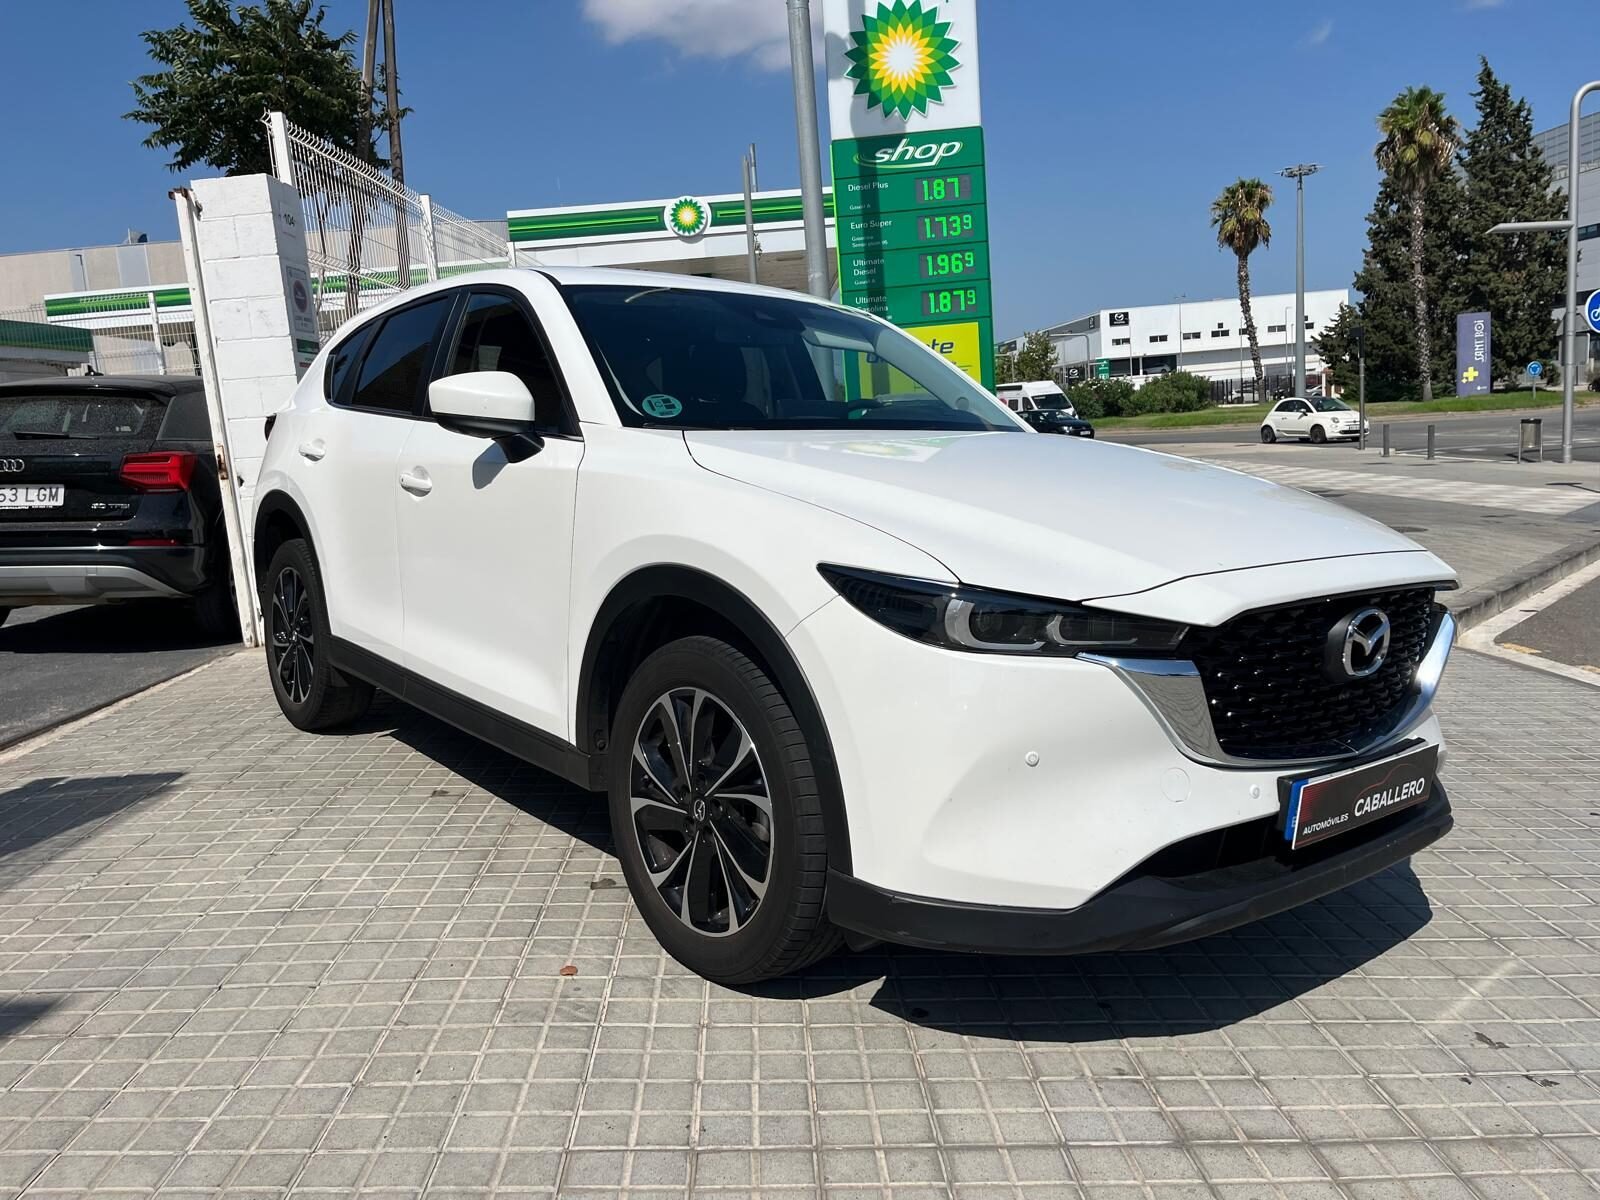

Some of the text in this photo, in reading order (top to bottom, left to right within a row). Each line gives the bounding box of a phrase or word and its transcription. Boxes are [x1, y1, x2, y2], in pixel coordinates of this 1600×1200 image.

[874, 138, 963, 167] shop
[848, 181, 889, 192] Diesel Plus
[923, 177, 959, 201] 1.87
[850, 219, 892, 230] Euro Super
[924, 214, 972, 239] 1.739
[853, 258, 885, 267] Ultimate
[854, 268, 877, 276] Diesel
[927, 251, 975, 276] 1.969
[855, 295, 887, 304] Ultimate
[929, 289, 976, 314] 1.879
[25, 487, 59, 502] LGM
[1302, 777, 1425, 836] AUTOMÓVILES CABALLERO
